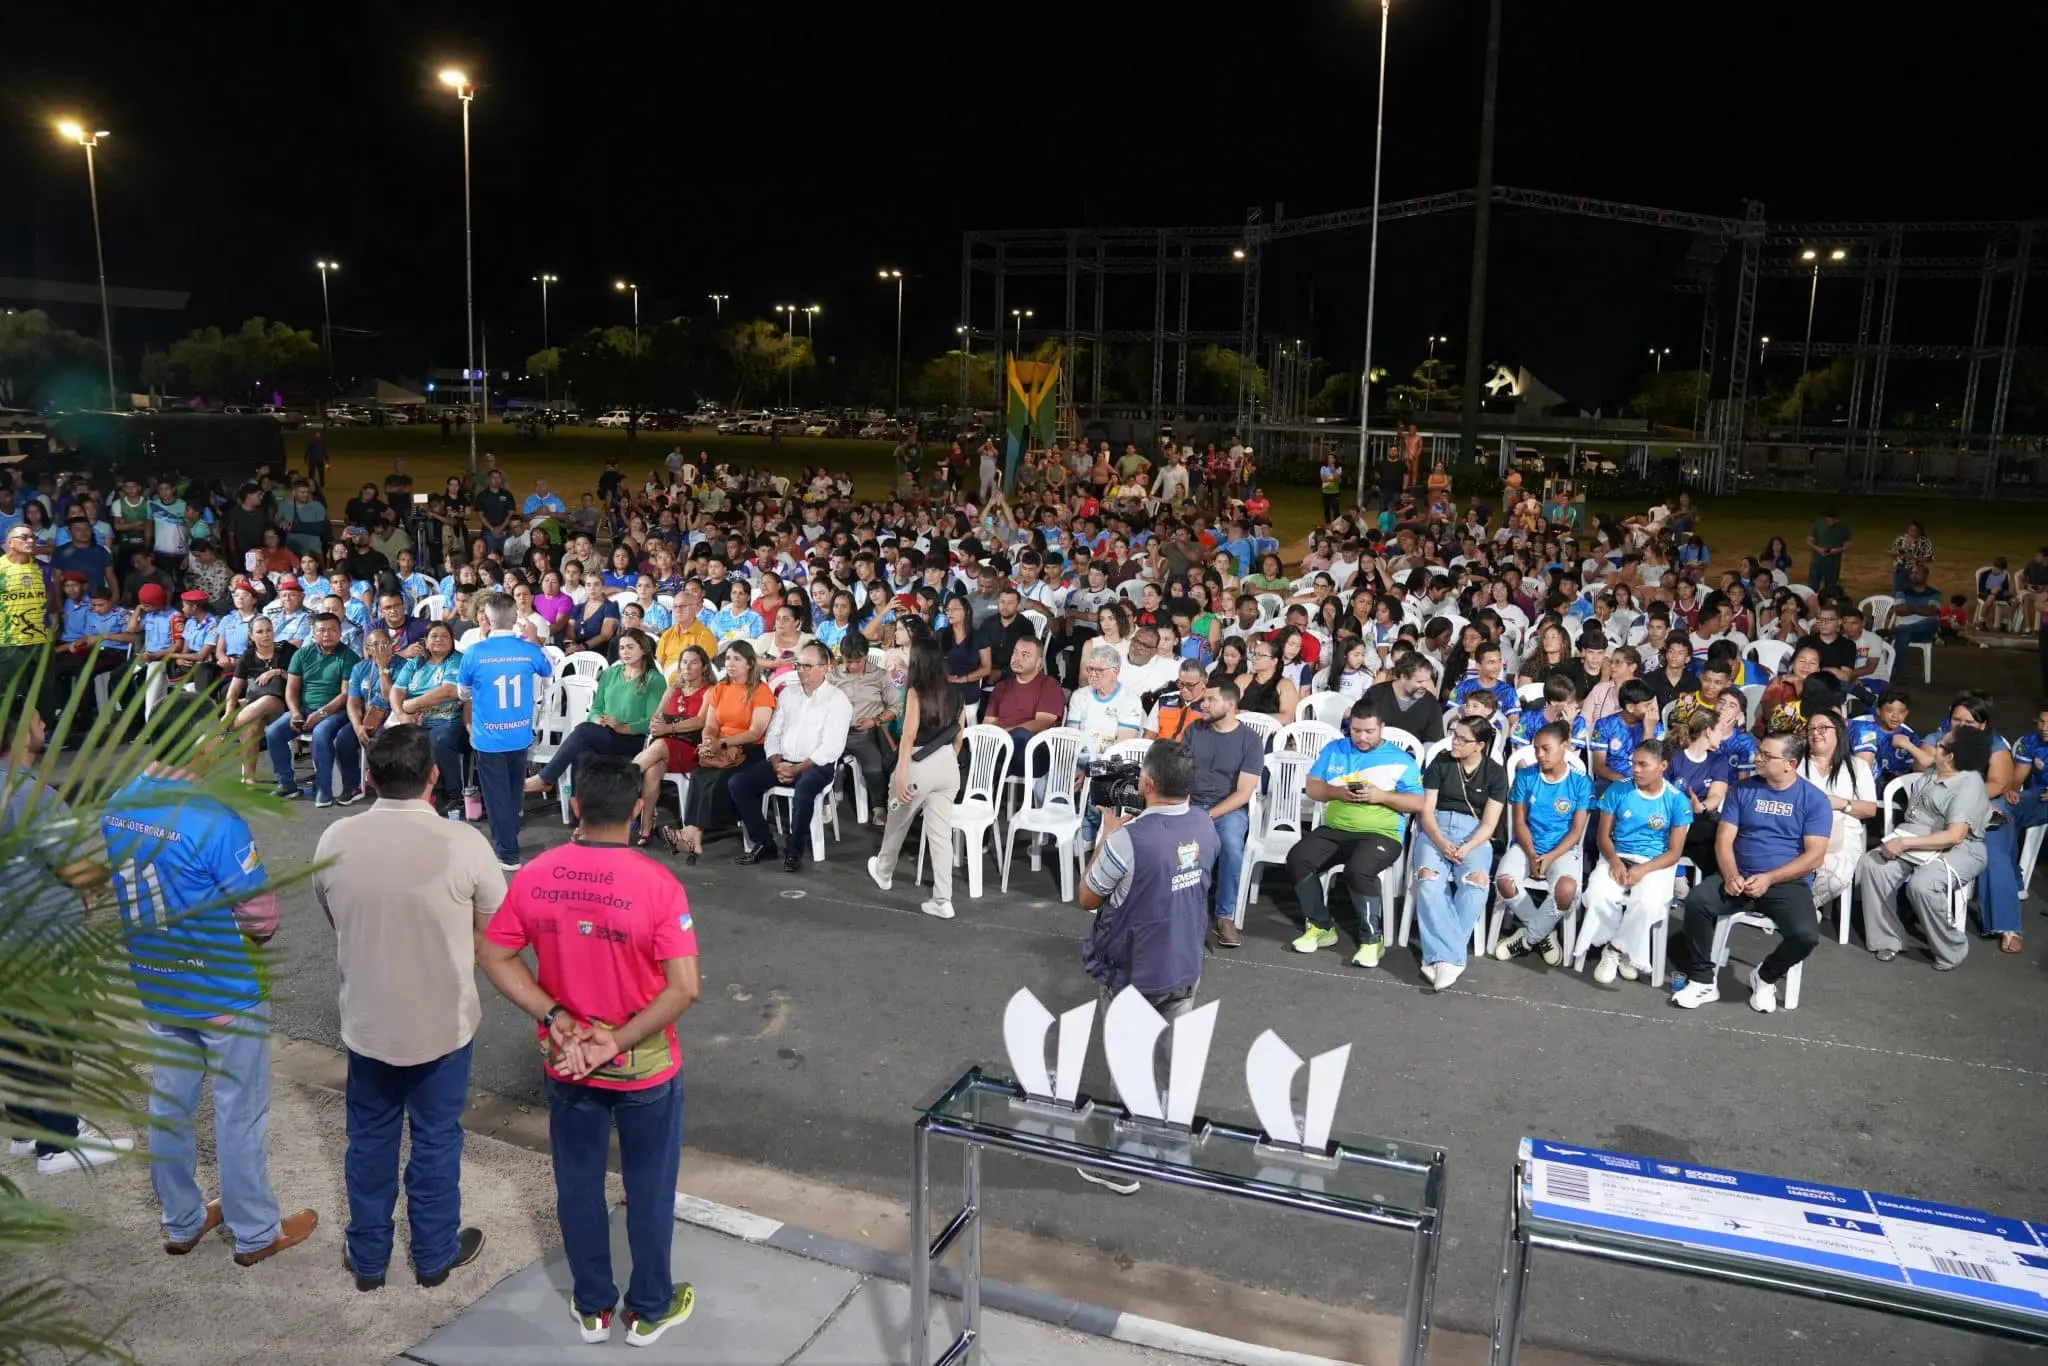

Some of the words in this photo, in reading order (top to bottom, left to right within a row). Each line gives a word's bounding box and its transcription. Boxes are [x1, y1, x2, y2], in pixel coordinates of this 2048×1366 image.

[493, 673, 521, 709] 11
[1755, 799, 1793, 816] BOSS
[144, 824, 181, 843] RORAMA
[531, 886, 632, 911] Organizador
[1788, 1190, 1847, 1203] IMEDIATO
[1877, 1200, 1933, 1215] EMBARQUE
[1935, 1210, 1987, 1224] IMEDIATO
